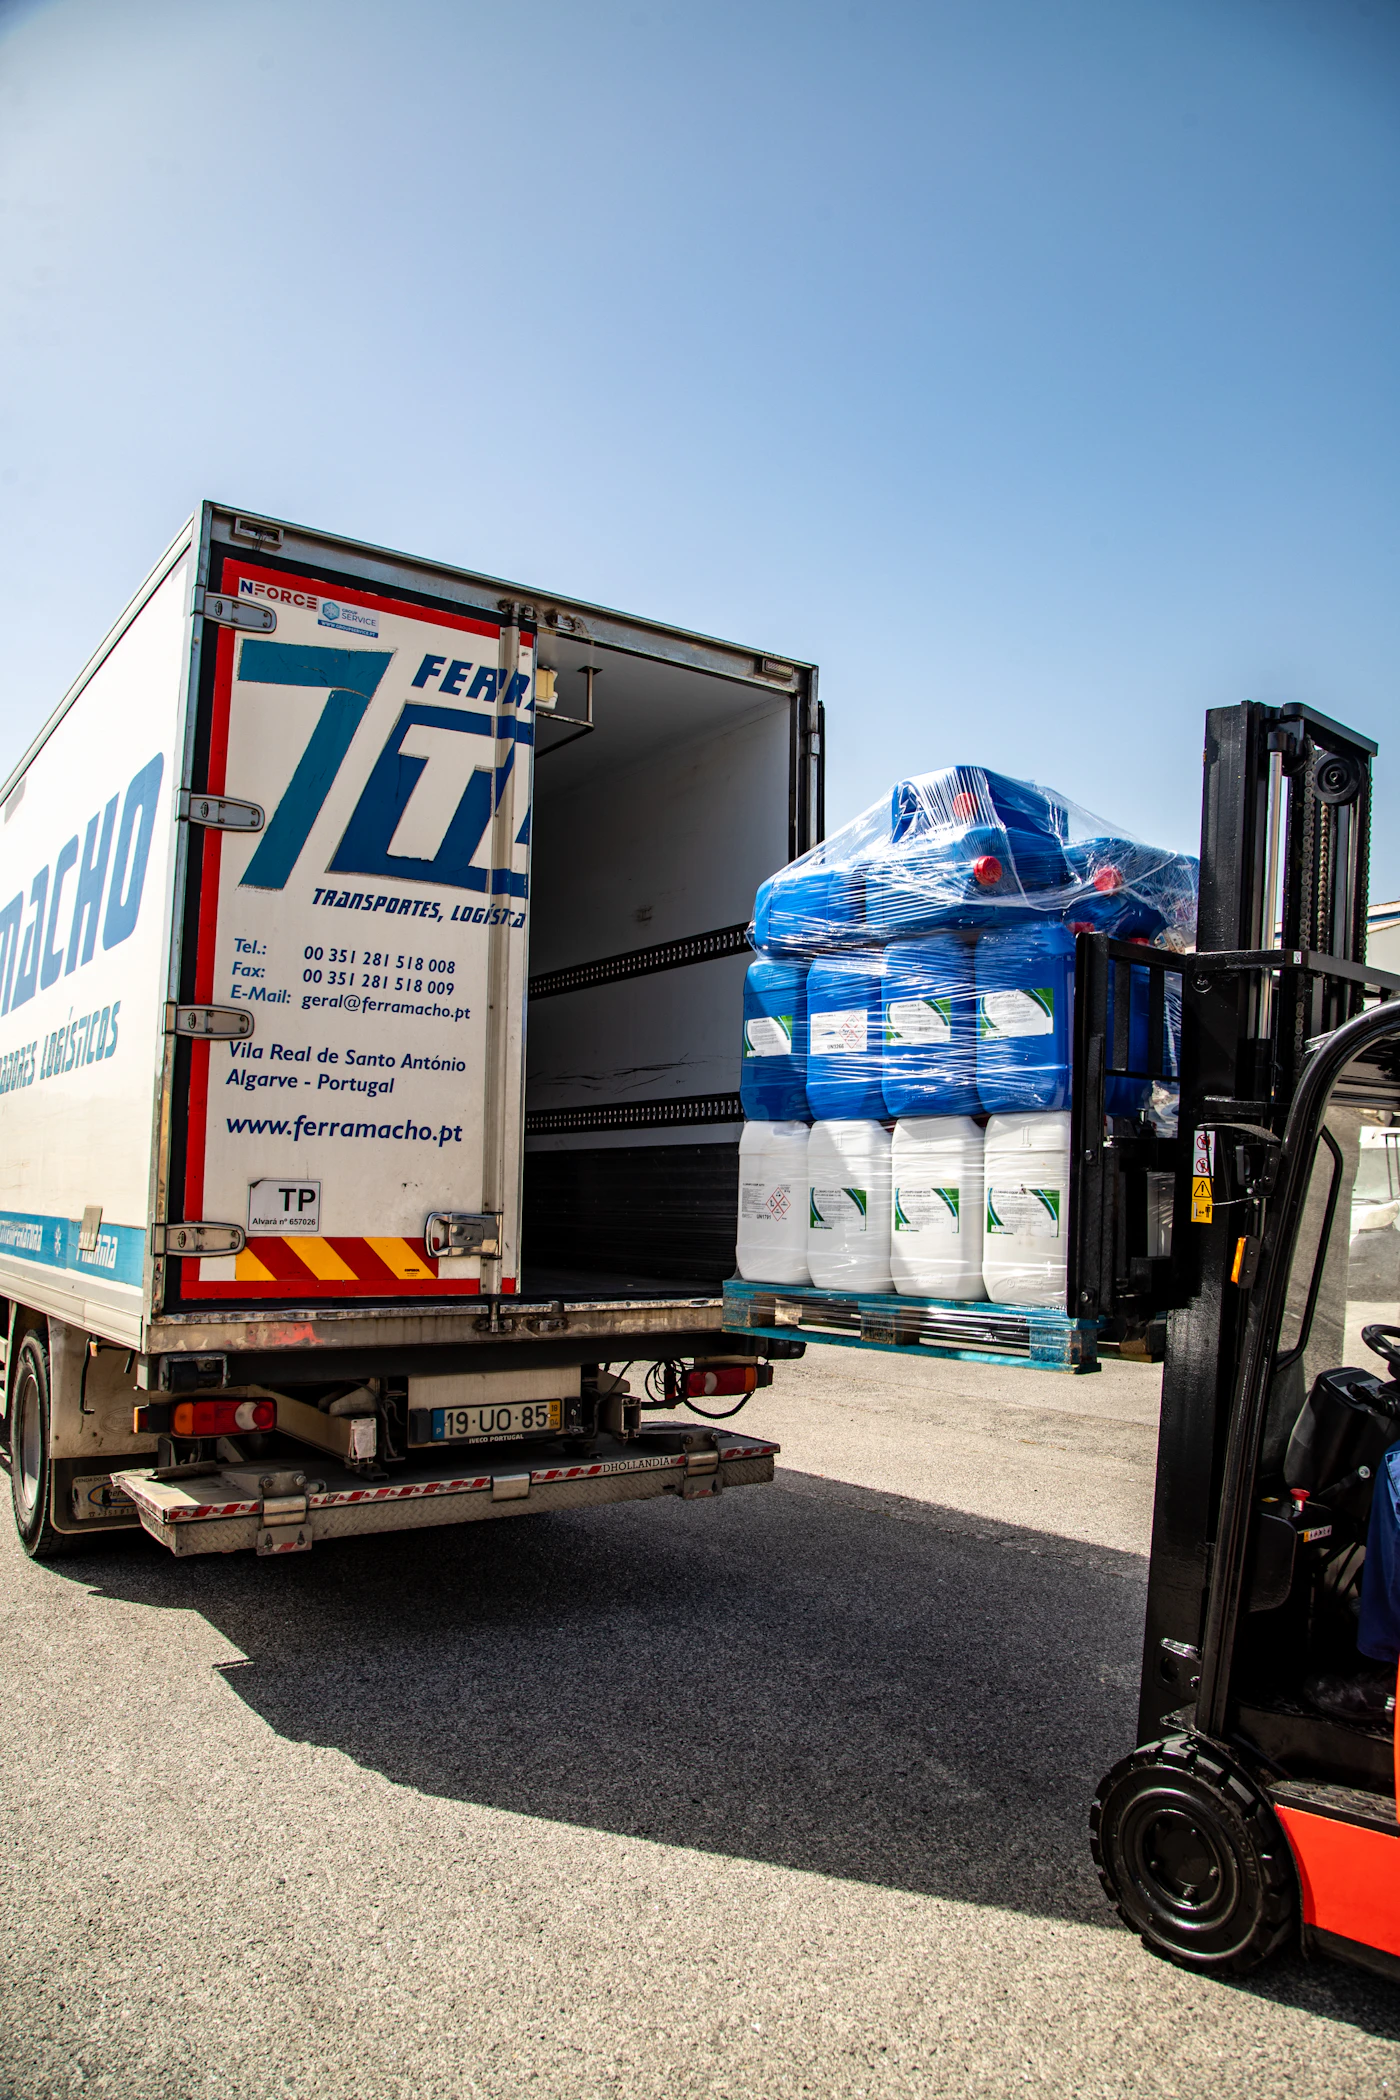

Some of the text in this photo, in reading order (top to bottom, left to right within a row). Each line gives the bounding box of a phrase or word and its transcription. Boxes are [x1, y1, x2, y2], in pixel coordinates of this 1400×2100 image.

[341, 612, 377, 627] SERVICE
[311, 887, 444, 922] TRANSPORTES,
[234, 938, 455, 974] Tel.: 00 351 281 518 008
[231, 961, 455, 996] Fax: 00 351 281 518 009
[230, 984, 471, 1020] E-Mail: geral@ferramacho.pt
[39, 1000, 121, 1080] LOGÍSTICOS
[228, 1040, 466, 1072] Vila Real de Santo António
[226, 1068, 298, 1091] Algarve
[317, 1073, 395, 1097] Portugal
[226, 1114, 463, 1147] www.ferramacho.pt
[278, 1188, 316, 1212] TP
[252, 1216, 277, 1226] Alvará
[289, 1217, 316, 1226] 657026
[436, 1427, 442, 1435] P
[551, 1404, 558, 1412] 18
[489, 1434, 524, 1443] PORTUGAL
[602, 1458, 670, 1473] DHOLLANDIA
